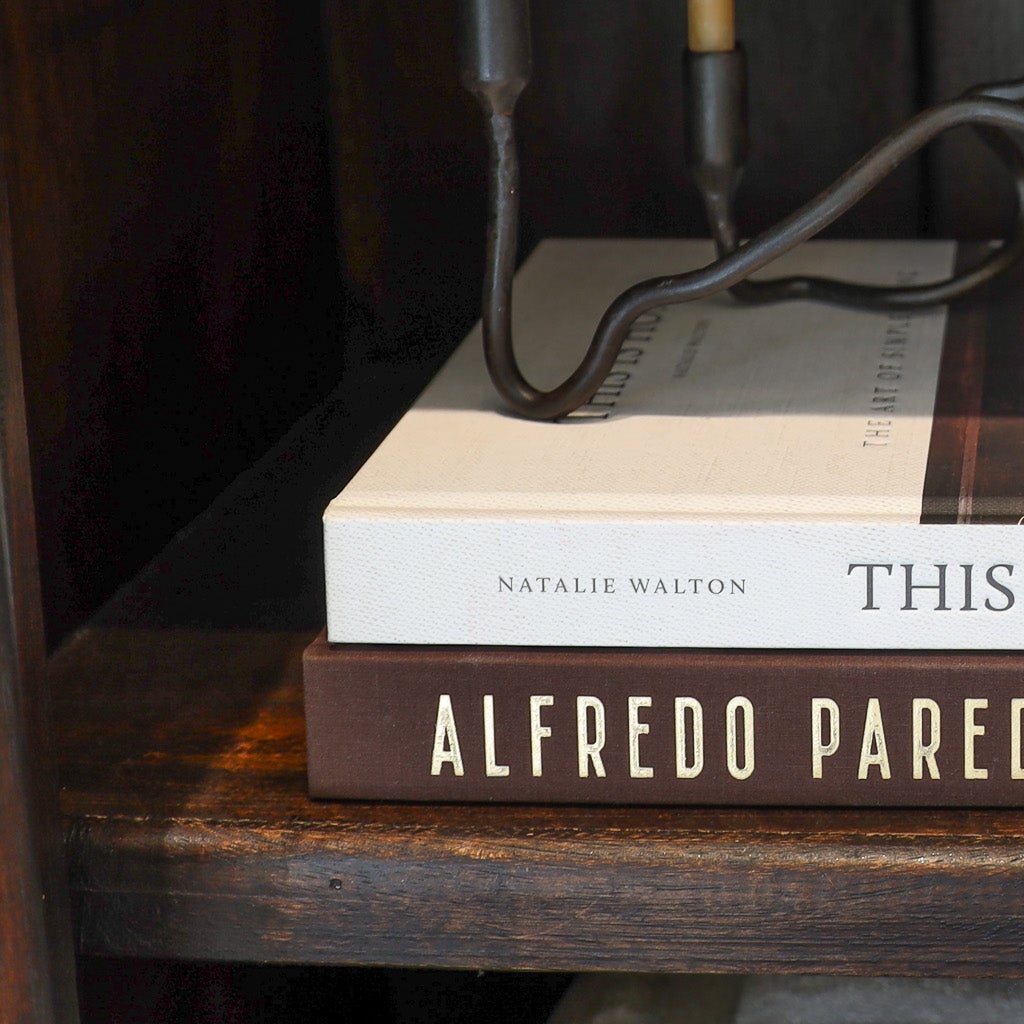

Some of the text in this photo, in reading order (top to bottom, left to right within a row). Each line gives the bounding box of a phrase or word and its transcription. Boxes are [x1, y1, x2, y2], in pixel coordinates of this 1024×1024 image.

[877, 363, 903, 381] OF
[871, 384, 899, 413] ART
[863, 419, 892, 447] THE
[498, 576, 747, 595] NATALIE WALTON
[848, 564, 1014, 611] THIS
[431, 695, 754, 779] ALFREDO
